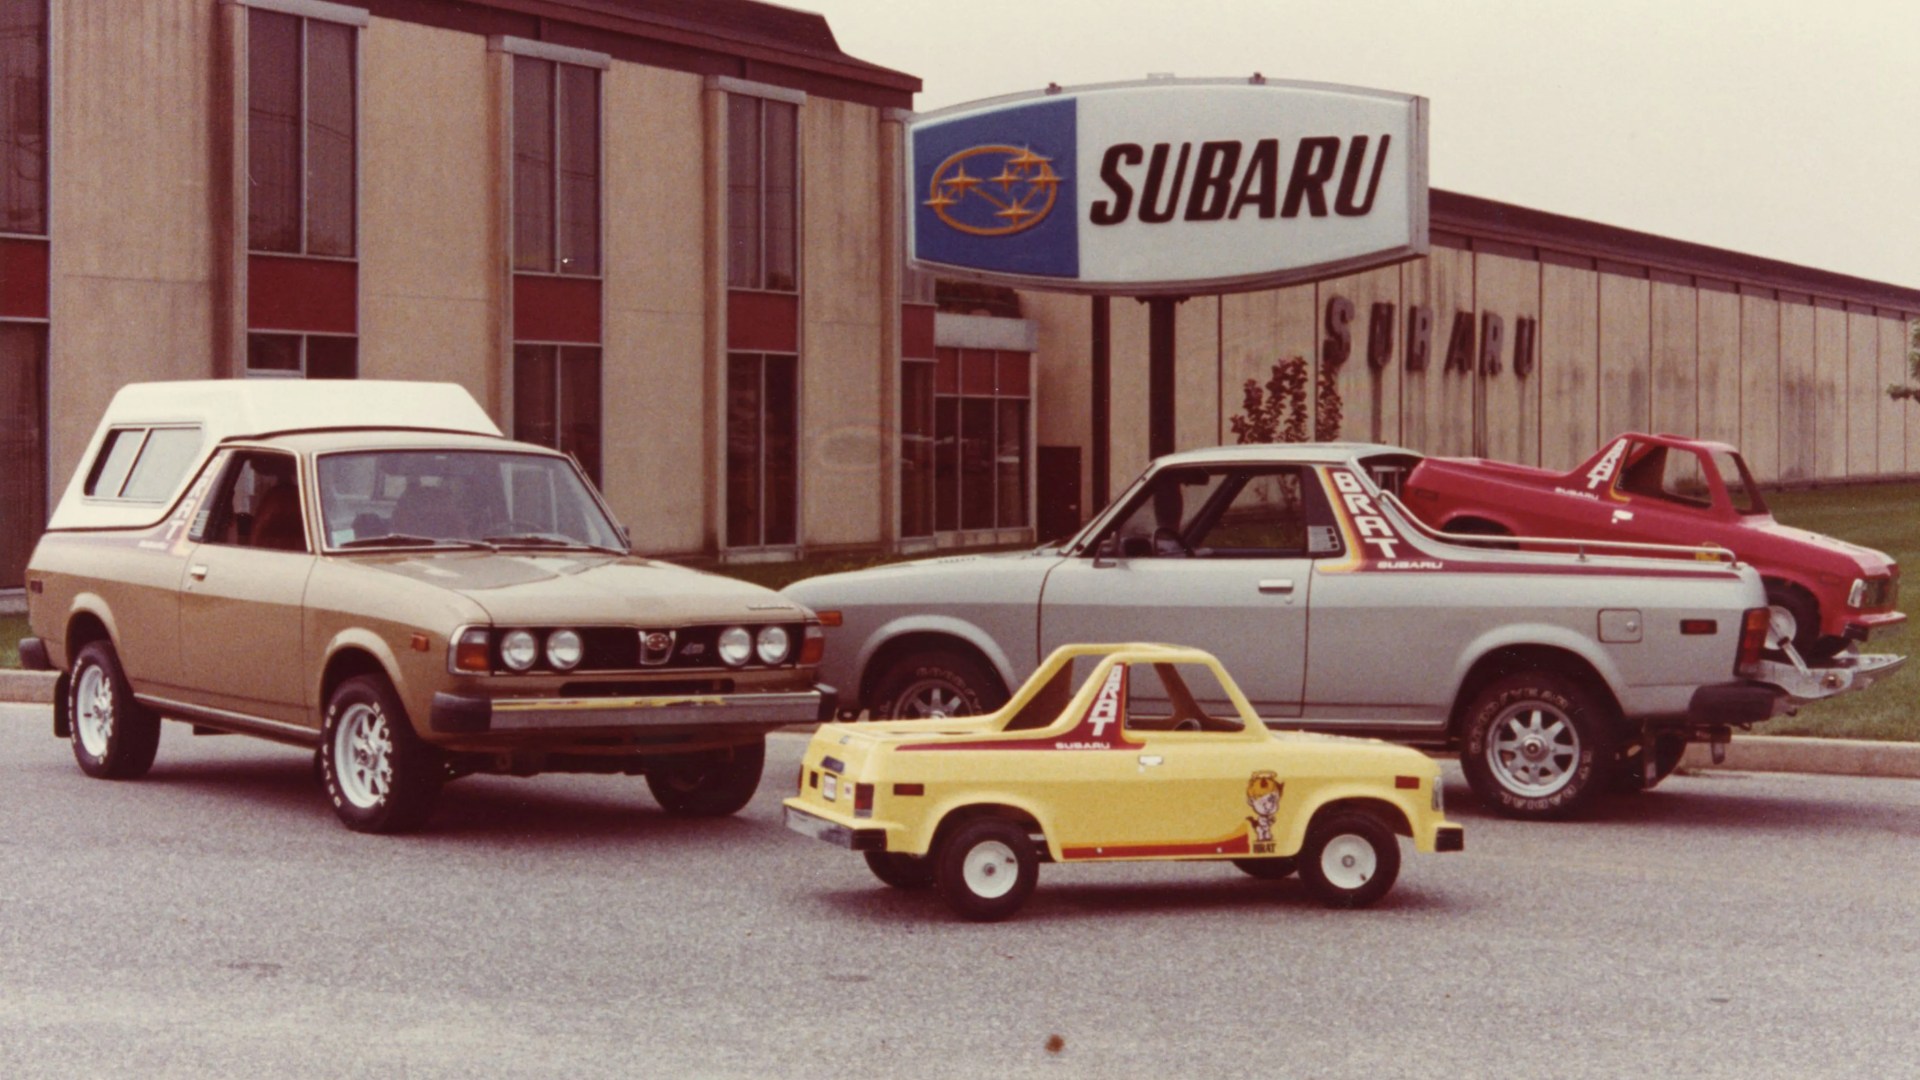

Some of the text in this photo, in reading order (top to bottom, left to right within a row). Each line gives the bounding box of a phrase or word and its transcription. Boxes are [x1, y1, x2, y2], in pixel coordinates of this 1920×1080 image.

[1090, 134, 1391, 226] SUBARU
[1322, 295, 1537, 377] SUBARU
[1554, 486, 1600, 501] SUBARU
[1586, 438, 1627, 489] BRAT
[1332, 471, 1400, 559] BRAT
[1377, 561, 1443, 570] SUBARU
[1087, 665, 1123, 737] BRAT
[1055, 742, 1111, 750] SUBARU
